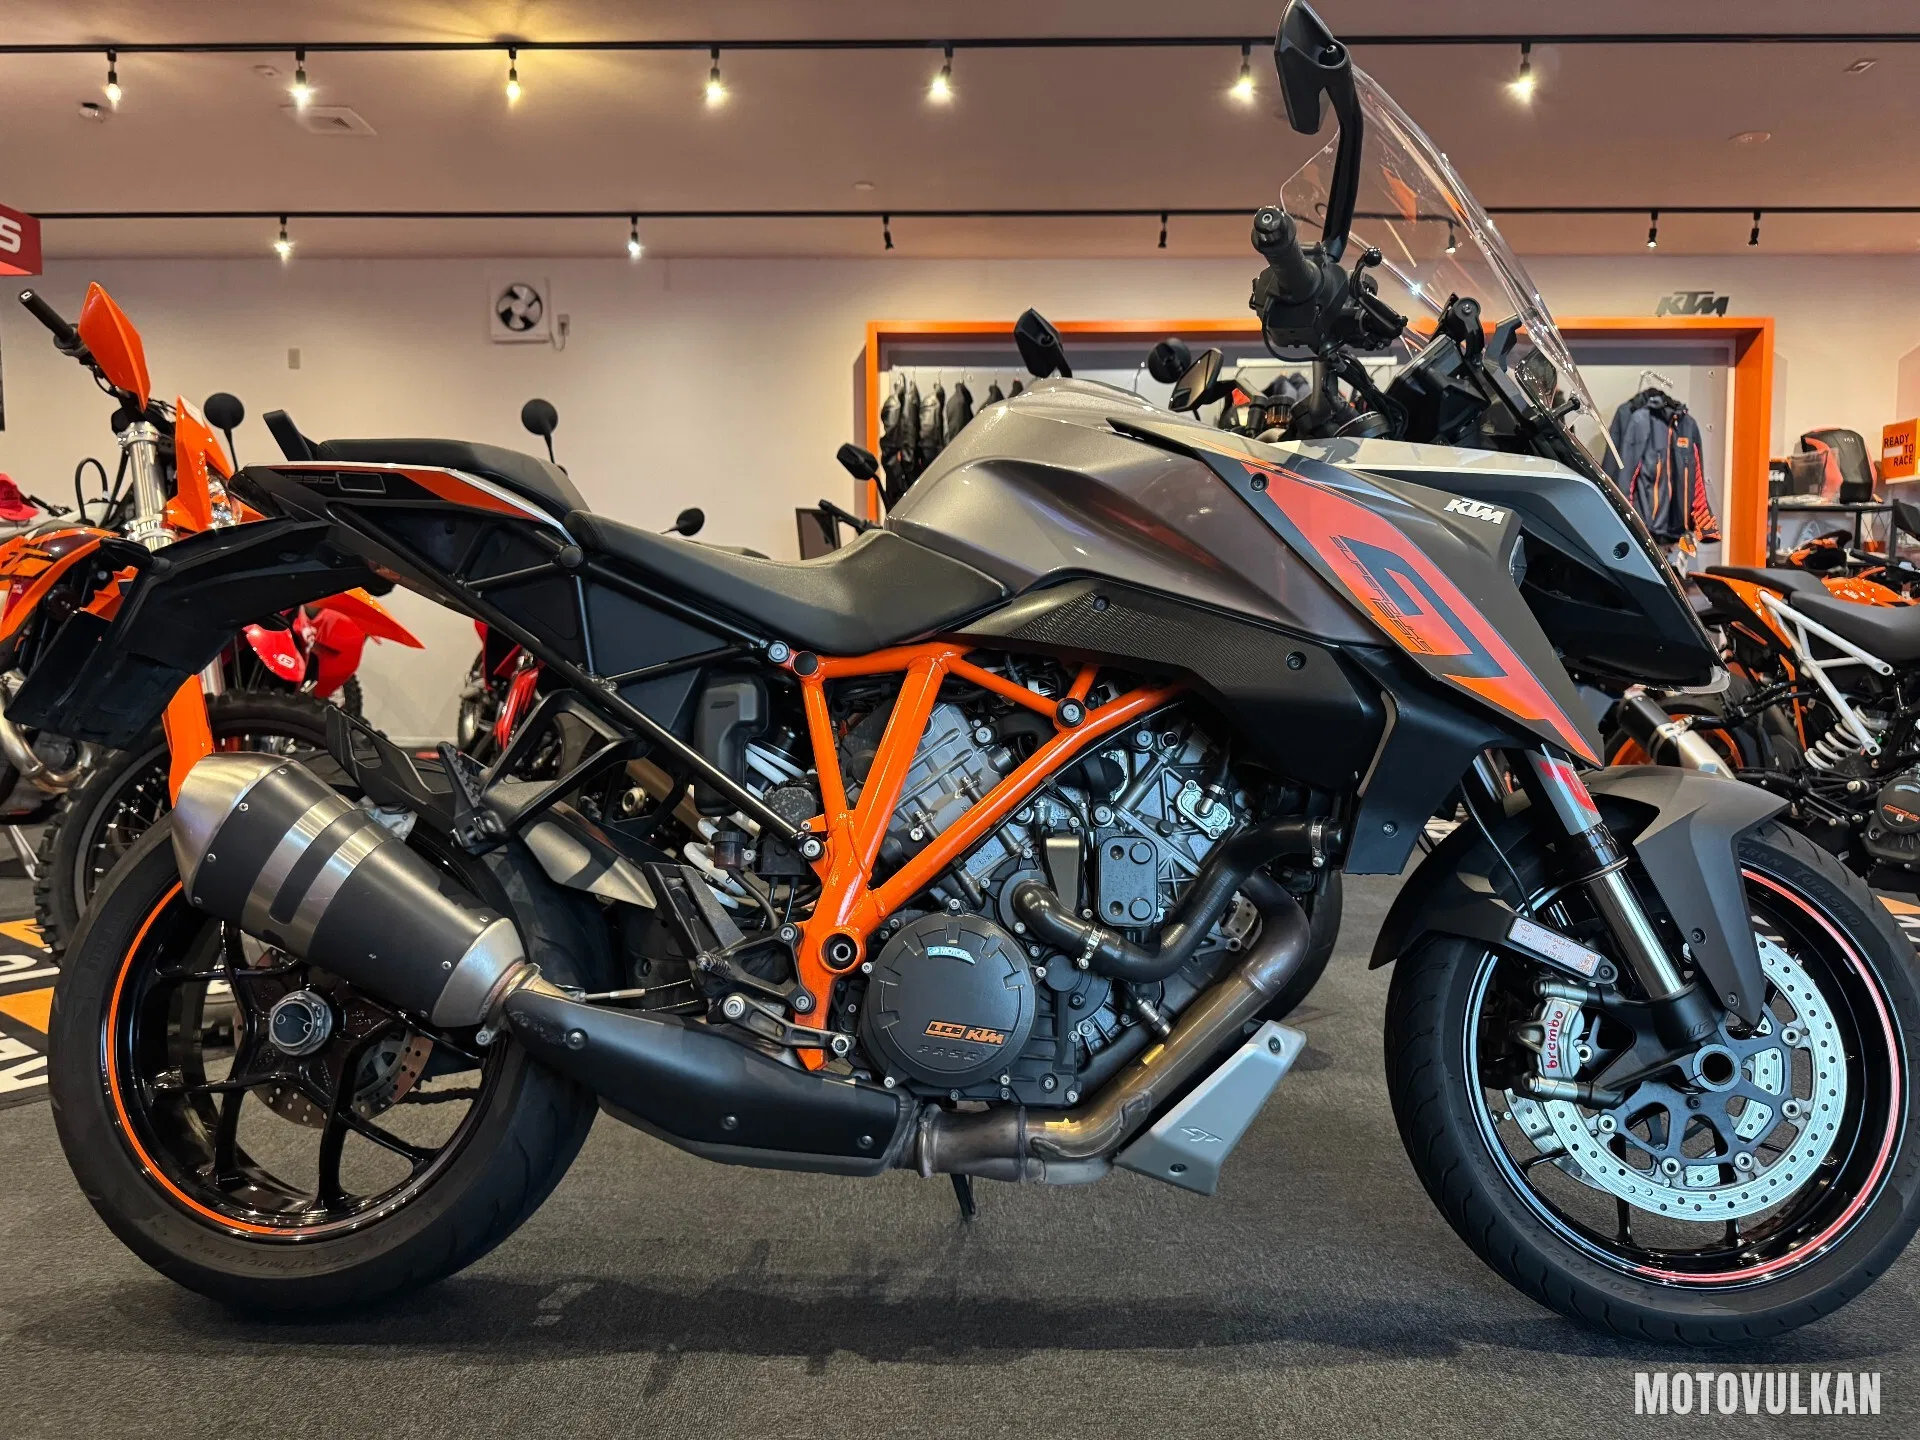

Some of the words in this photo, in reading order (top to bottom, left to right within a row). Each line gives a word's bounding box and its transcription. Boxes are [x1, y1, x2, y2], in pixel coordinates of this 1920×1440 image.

[1655, 291, 1730, 315] KTM
[1883, 433, 1909, 448] READY
[1904, 444, 1914, 455] TO
[1893, 455, 1913, 467] RACE
[1443, 497, 1506, 525] KTM
[964, 1027, 1005, 1045] KTM
[1545, 1010, 1564, 1069] brembo
